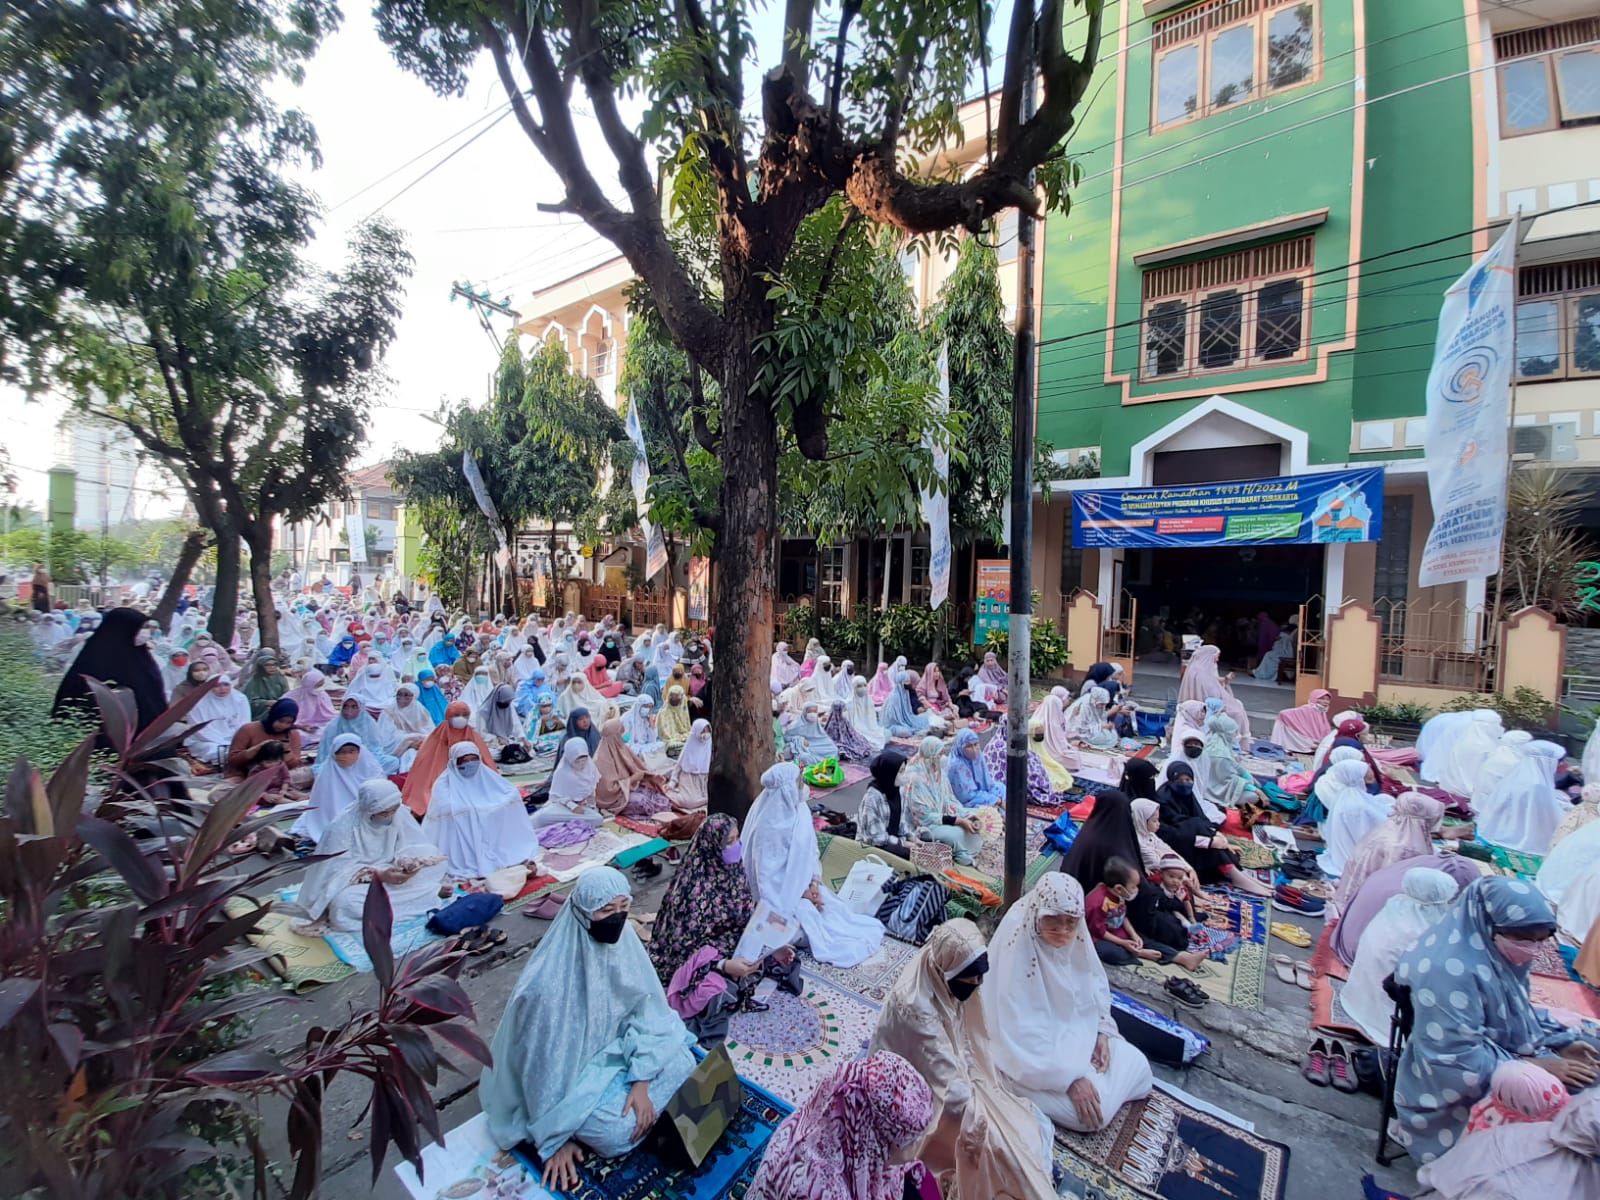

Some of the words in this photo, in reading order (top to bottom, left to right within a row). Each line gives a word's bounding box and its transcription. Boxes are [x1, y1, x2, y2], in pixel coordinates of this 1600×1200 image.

[1121, 491, 1158, 501] Semarak
[1160, 489, 1210, 499] Ramadhan
[1215, 486, 1240, 495] 1443
[1285, 480, 1299, 491] M
[1262, 494, 1299, 502] SURAKARTA
